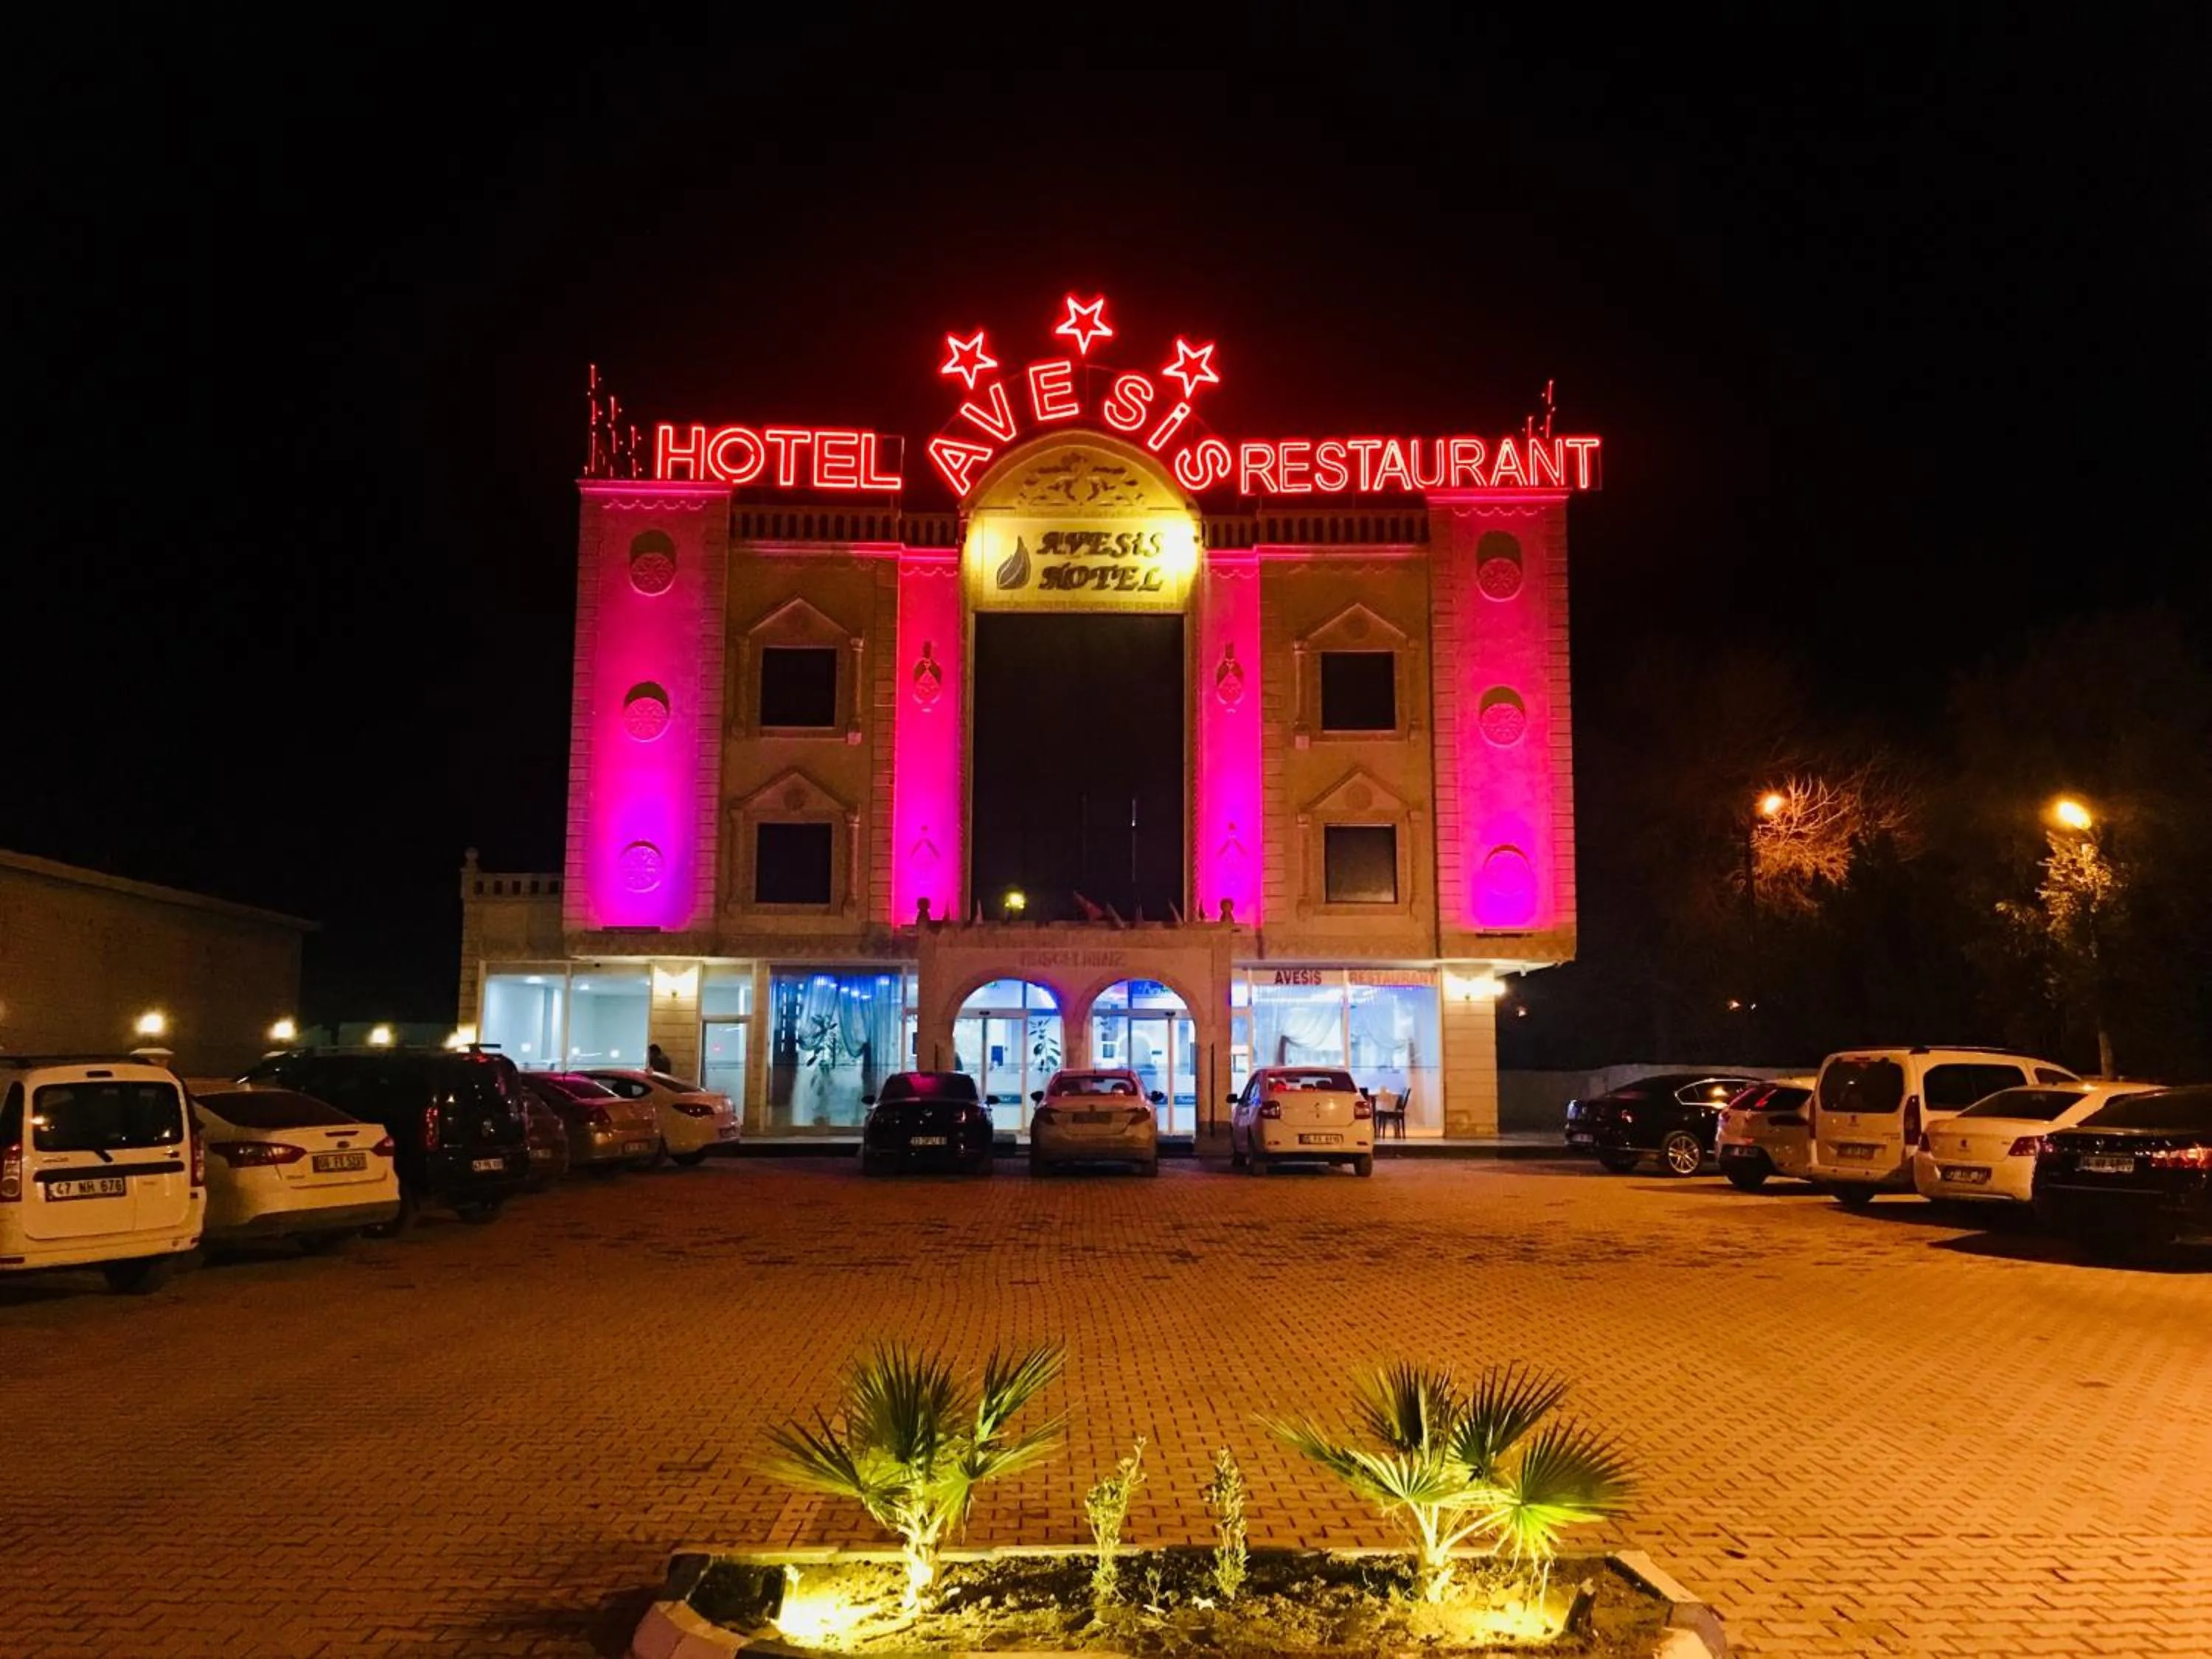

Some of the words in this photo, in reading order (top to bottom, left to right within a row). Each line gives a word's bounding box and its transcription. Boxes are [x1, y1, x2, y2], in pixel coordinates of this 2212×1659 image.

[657, 425, 901, 490] HOTEL
[1241, 439, 1600, 493] RESTAURANT
[56, 1182, 72, 1195] 47
